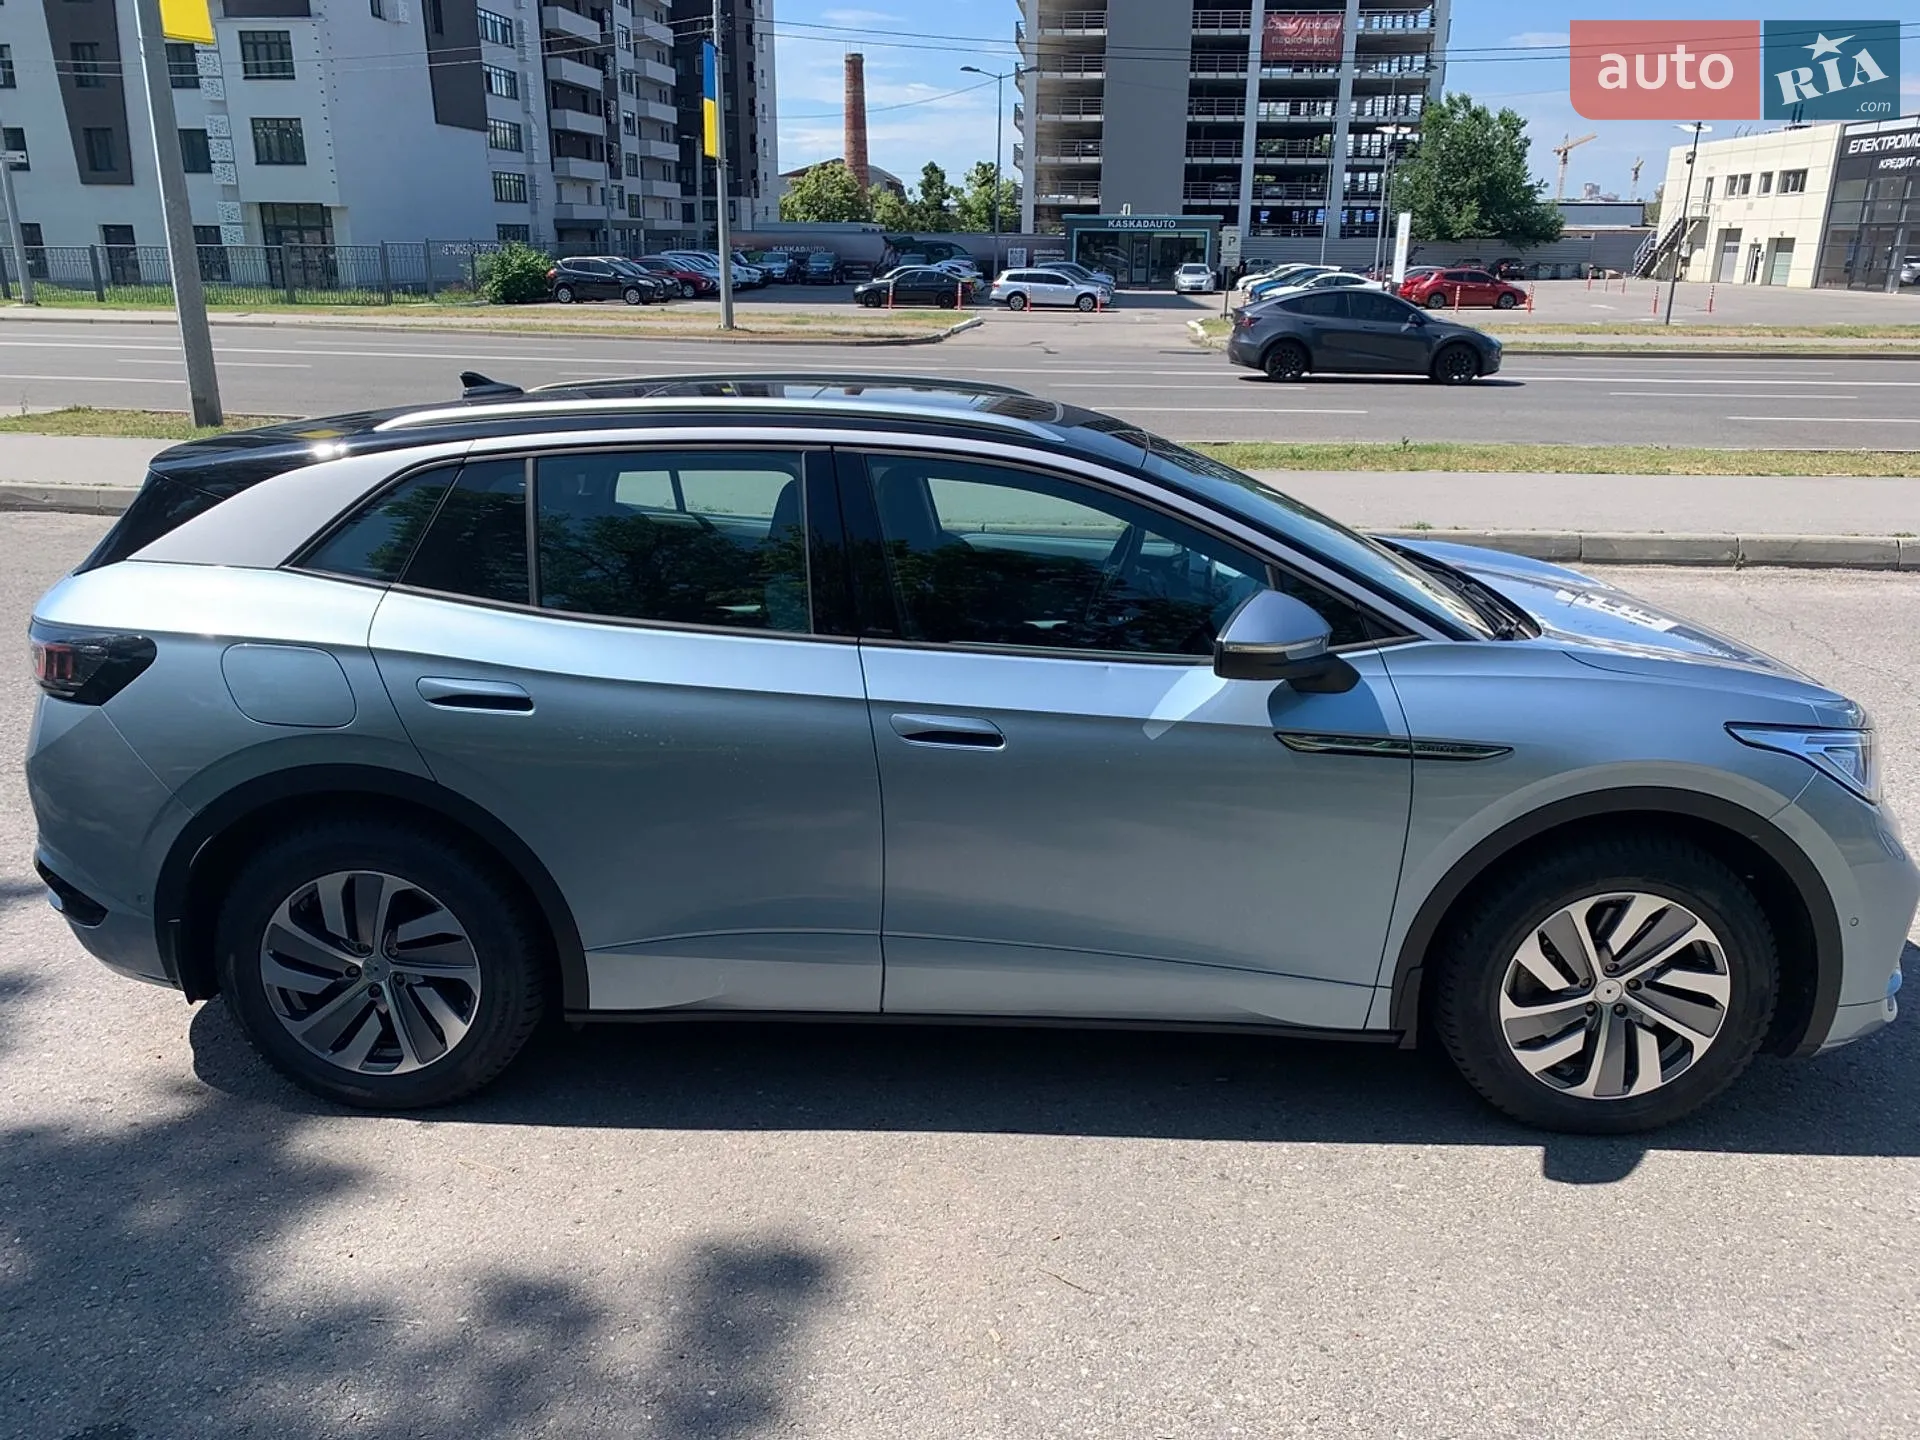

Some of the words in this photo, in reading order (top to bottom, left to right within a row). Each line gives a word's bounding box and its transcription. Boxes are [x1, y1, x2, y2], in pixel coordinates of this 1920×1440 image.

[1878, 156, 1916, 170] КРЕДИТ
[1107, 219, 1176, 229] KASKADAUTO
[771, 244, 826, 253] KASKADAUTO
